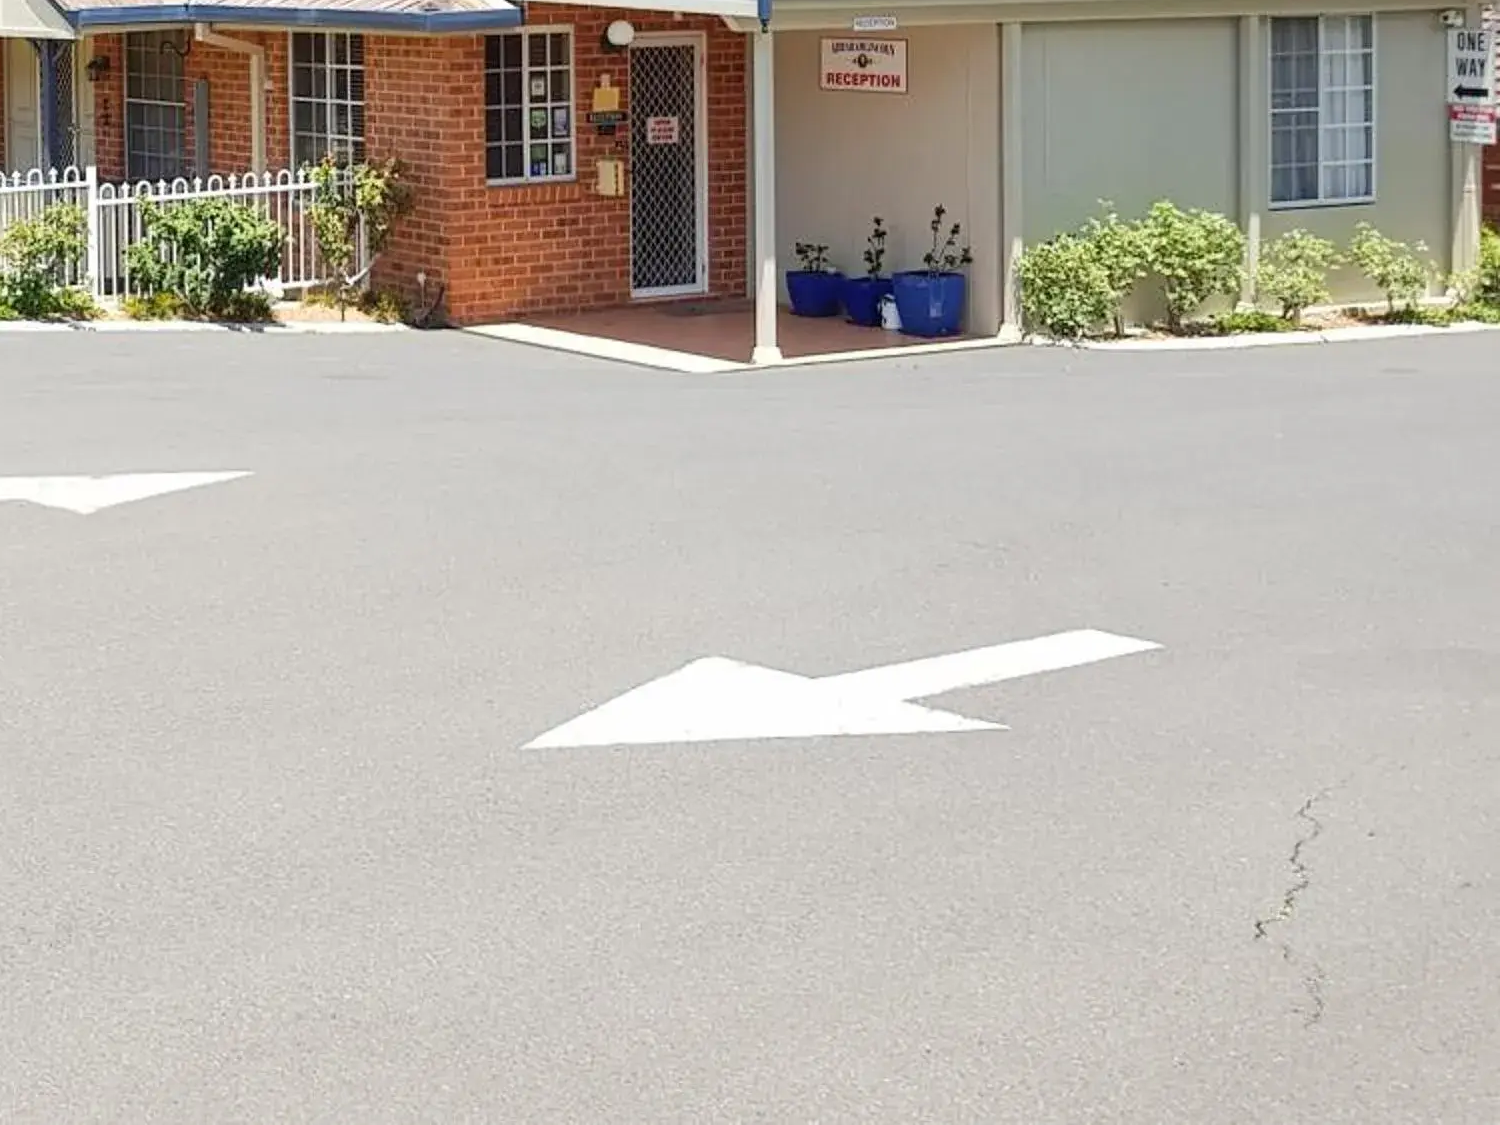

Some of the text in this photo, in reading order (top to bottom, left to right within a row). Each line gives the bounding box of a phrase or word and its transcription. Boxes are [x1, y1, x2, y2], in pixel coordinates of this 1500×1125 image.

[1457, 32, 1486, 52] ONE
[1454, 58, 1487, 77] WAY
[826, 72, 901, 88] RECEPTION
